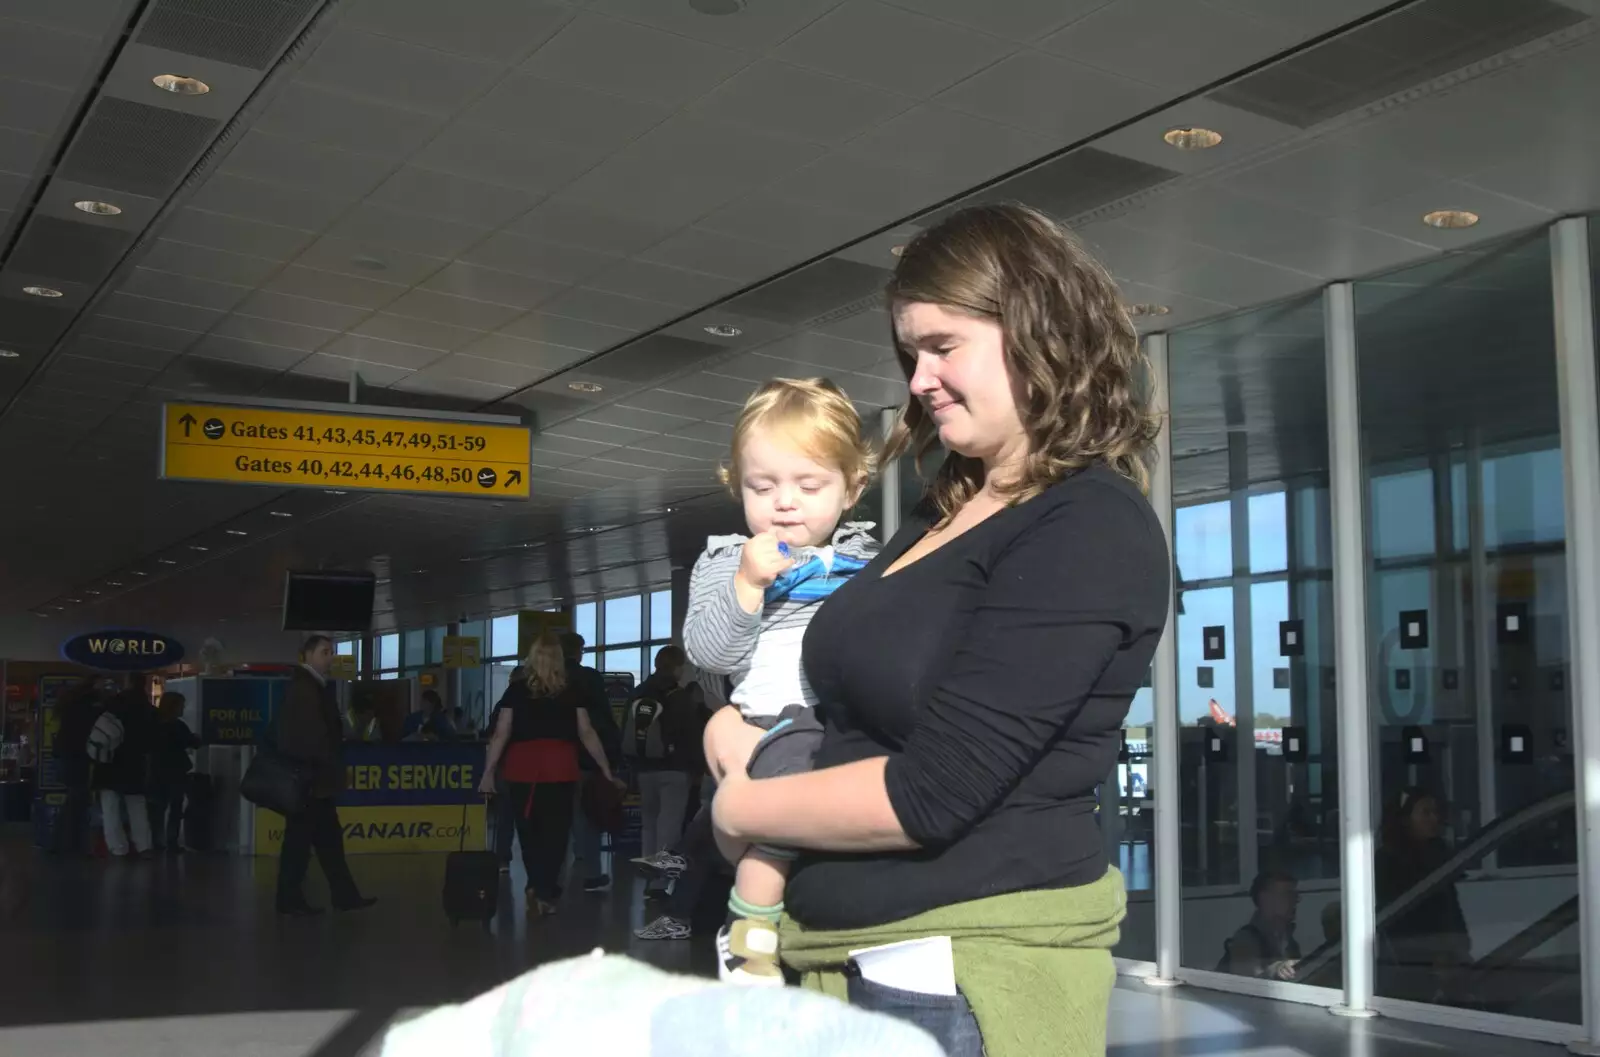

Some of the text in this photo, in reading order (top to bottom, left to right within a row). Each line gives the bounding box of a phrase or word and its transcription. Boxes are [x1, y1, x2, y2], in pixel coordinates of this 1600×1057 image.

[231, 420, 487, 452] Gates 41,43,45,47,49,51-59
[235, 455, 473, 485] Gates 40,42,44,46,48,50
[88, 638, 166, 655] WORLD
[209, 708, 236, 722] FOR
[218, 727, 254, 740] YOUR
[387, 763, 474, 790] SERVICE
